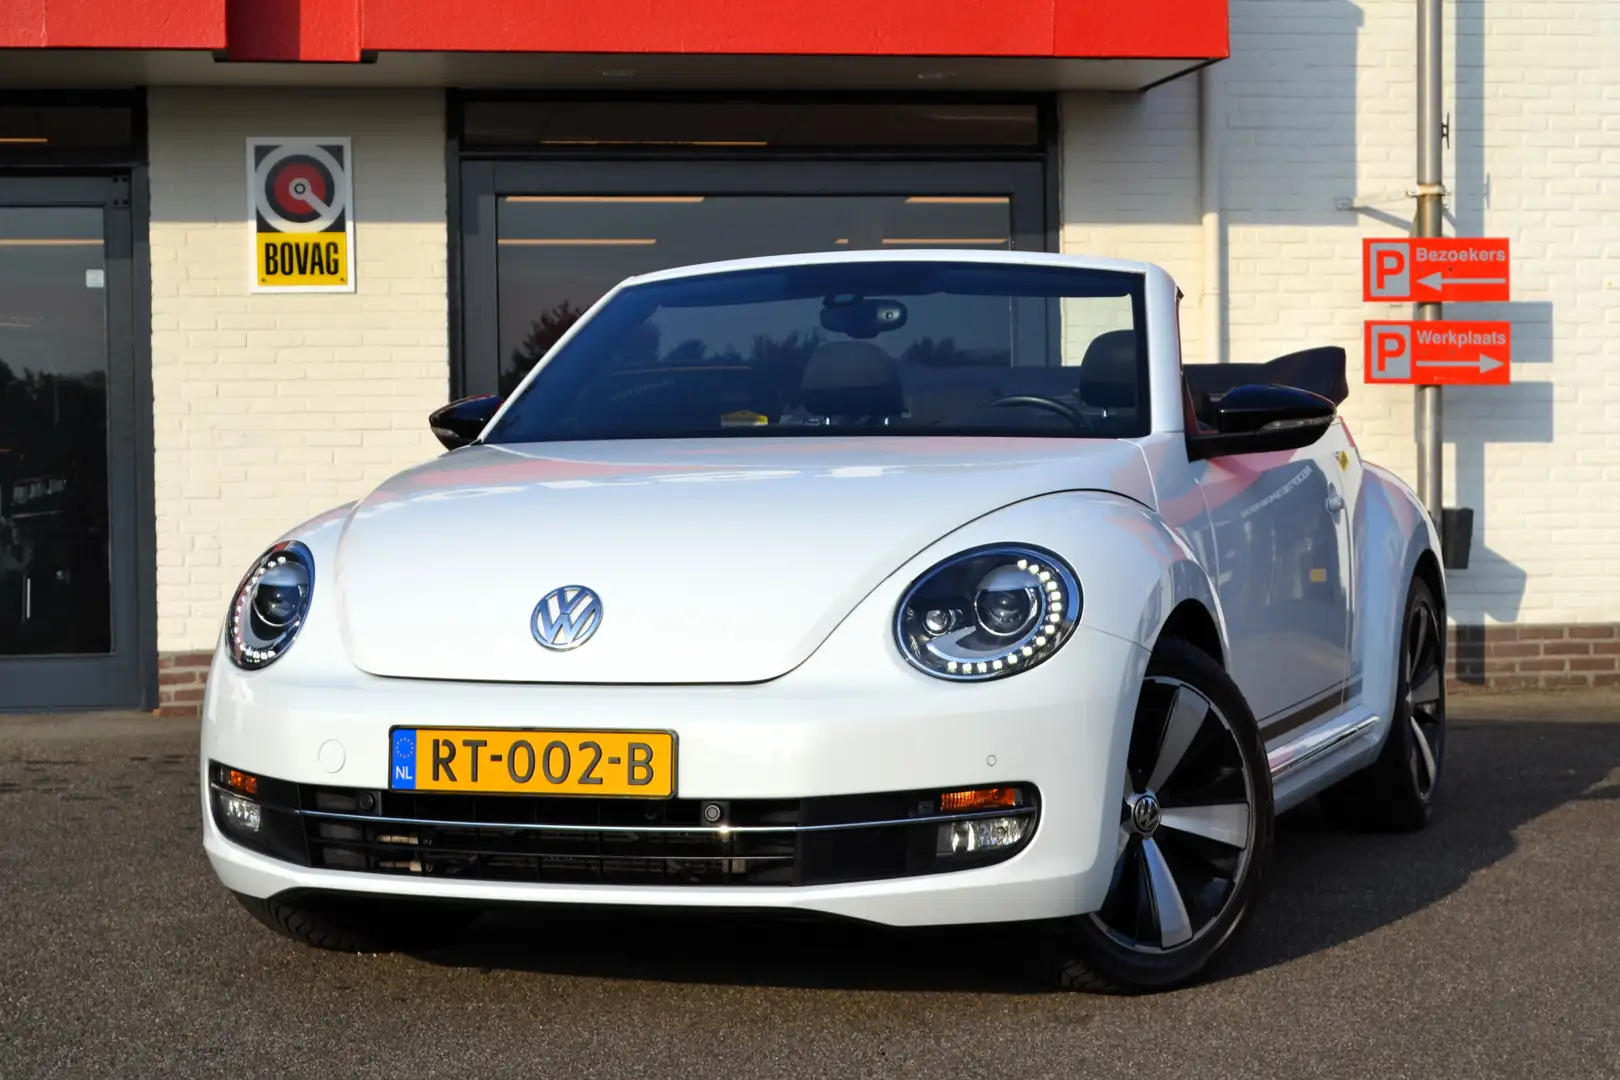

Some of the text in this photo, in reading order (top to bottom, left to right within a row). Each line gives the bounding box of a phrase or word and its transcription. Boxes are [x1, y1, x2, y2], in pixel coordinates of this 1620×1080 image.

[264, 241, 339, 276] BOVAG
[1376, 247, 1506, 290] P Bezoekers
[1377, 329, 1507, 372] P Werkplaats
[533, 585, 601, 648] VW
[395, 738, 655, 786] NL RT-002-B
